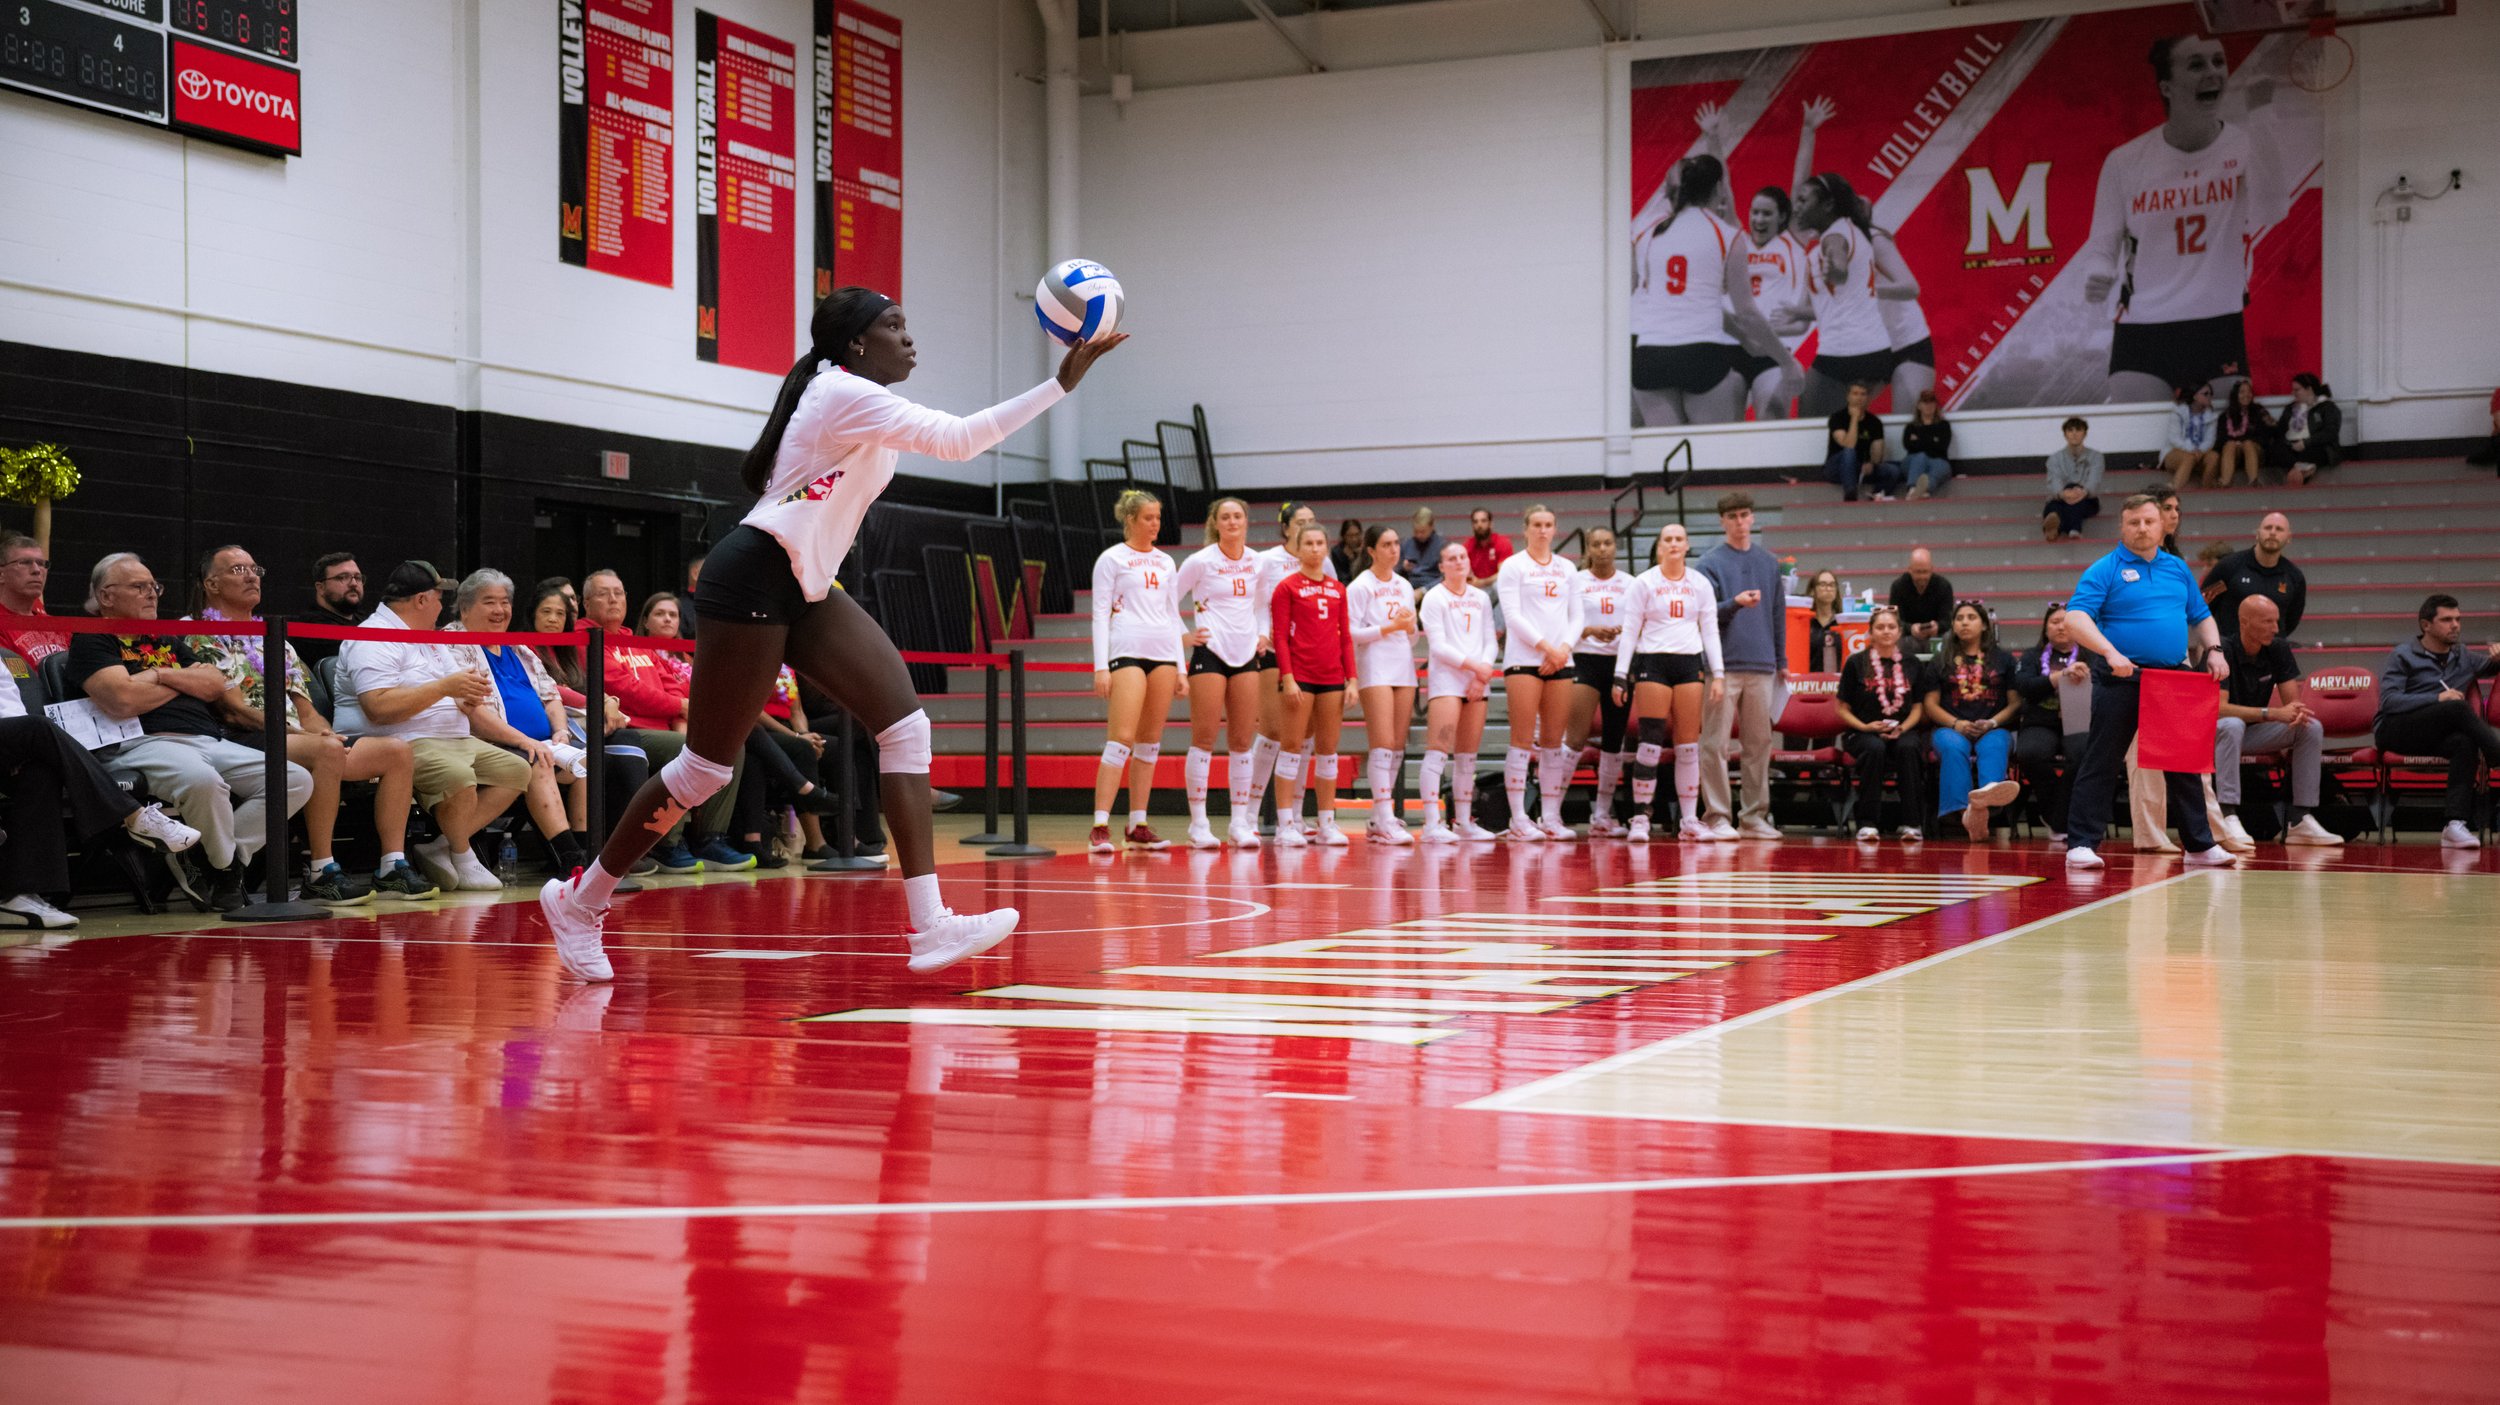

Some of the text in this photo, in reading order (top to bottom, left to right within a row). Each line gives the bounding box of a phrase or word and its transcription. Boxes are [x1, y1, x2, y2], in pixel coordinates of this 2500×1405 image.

[20, 7, 30, 26] 3
[103, 0, 146, 14] ORE
[113, 34, 124, 52] 4
[562, 0, 584, 105] VOLLEY
[213, 79, 296, 121] TOYOTA
[815, 35, 832, 182] VOLLEYBALL
[1867, 33, 2002, 180] VOLLEYBALL
[698, 60, 717, 215] VOLLEYBALL
[1964, 162, 2053, 255] M
[2174, 214, 2206, 256] 12
[1666, 255, 1688, 295] 9
[1942, 274, 2044, 390] MARYLAND
[1144, 571, 1159, 590] 14
[1232, 579, 1247, 596] 19
[1545, 580, 1557, 598] 12
[1317, 598, 1328, 619] 5
[1601, 597, 1614, 615] 16
[1669, 600, 1684, 618] 10
[1464, 613, 1471, 633] 7
[2310, 676, 2371, 688] MARYLAND
[793, 872, 2049, 1046] MARYLAND
